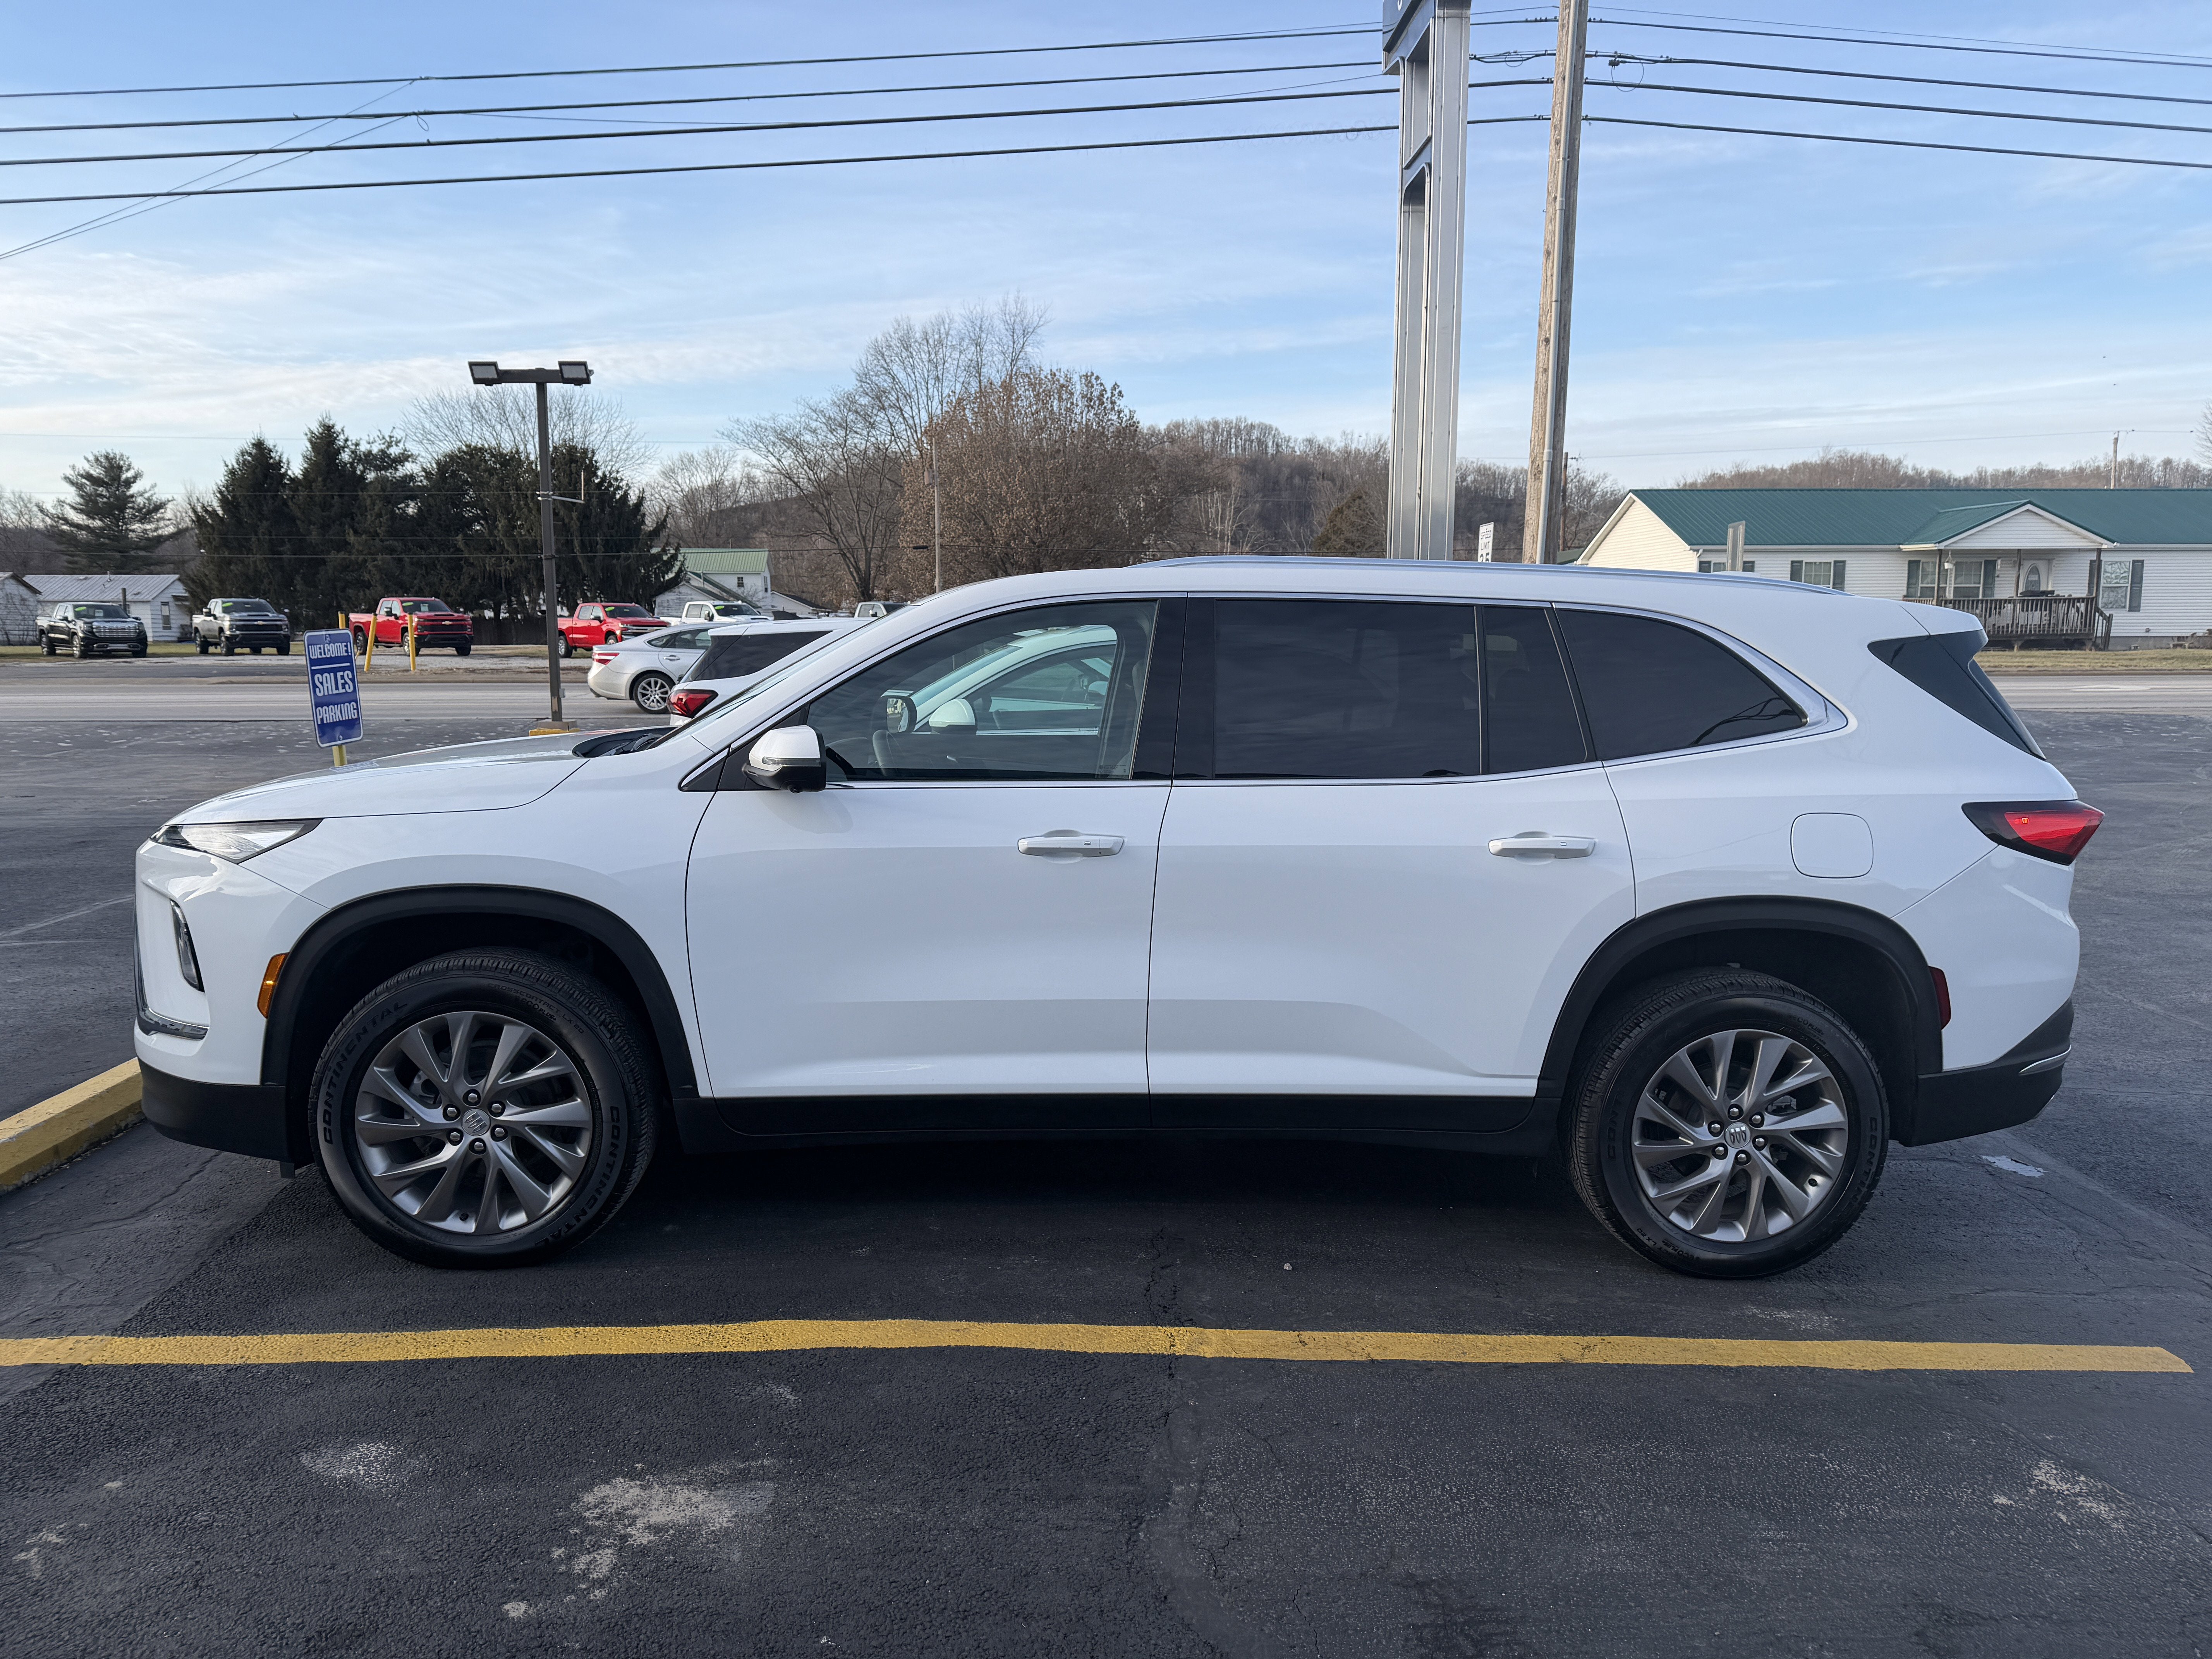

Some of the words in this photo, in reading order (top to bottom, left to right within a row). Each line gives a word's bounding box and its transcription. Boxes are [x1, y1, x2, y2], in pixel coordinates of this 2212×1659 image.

[309, 642, 351, 659] WELCOME!
[314, 670, 354, 697] SALES
[316, 702, 358, 725] PARKING
[323, 1001, 408, 1144] CONTINENTAL
[534, 1106, 620, 1246] CONTINENTAL
